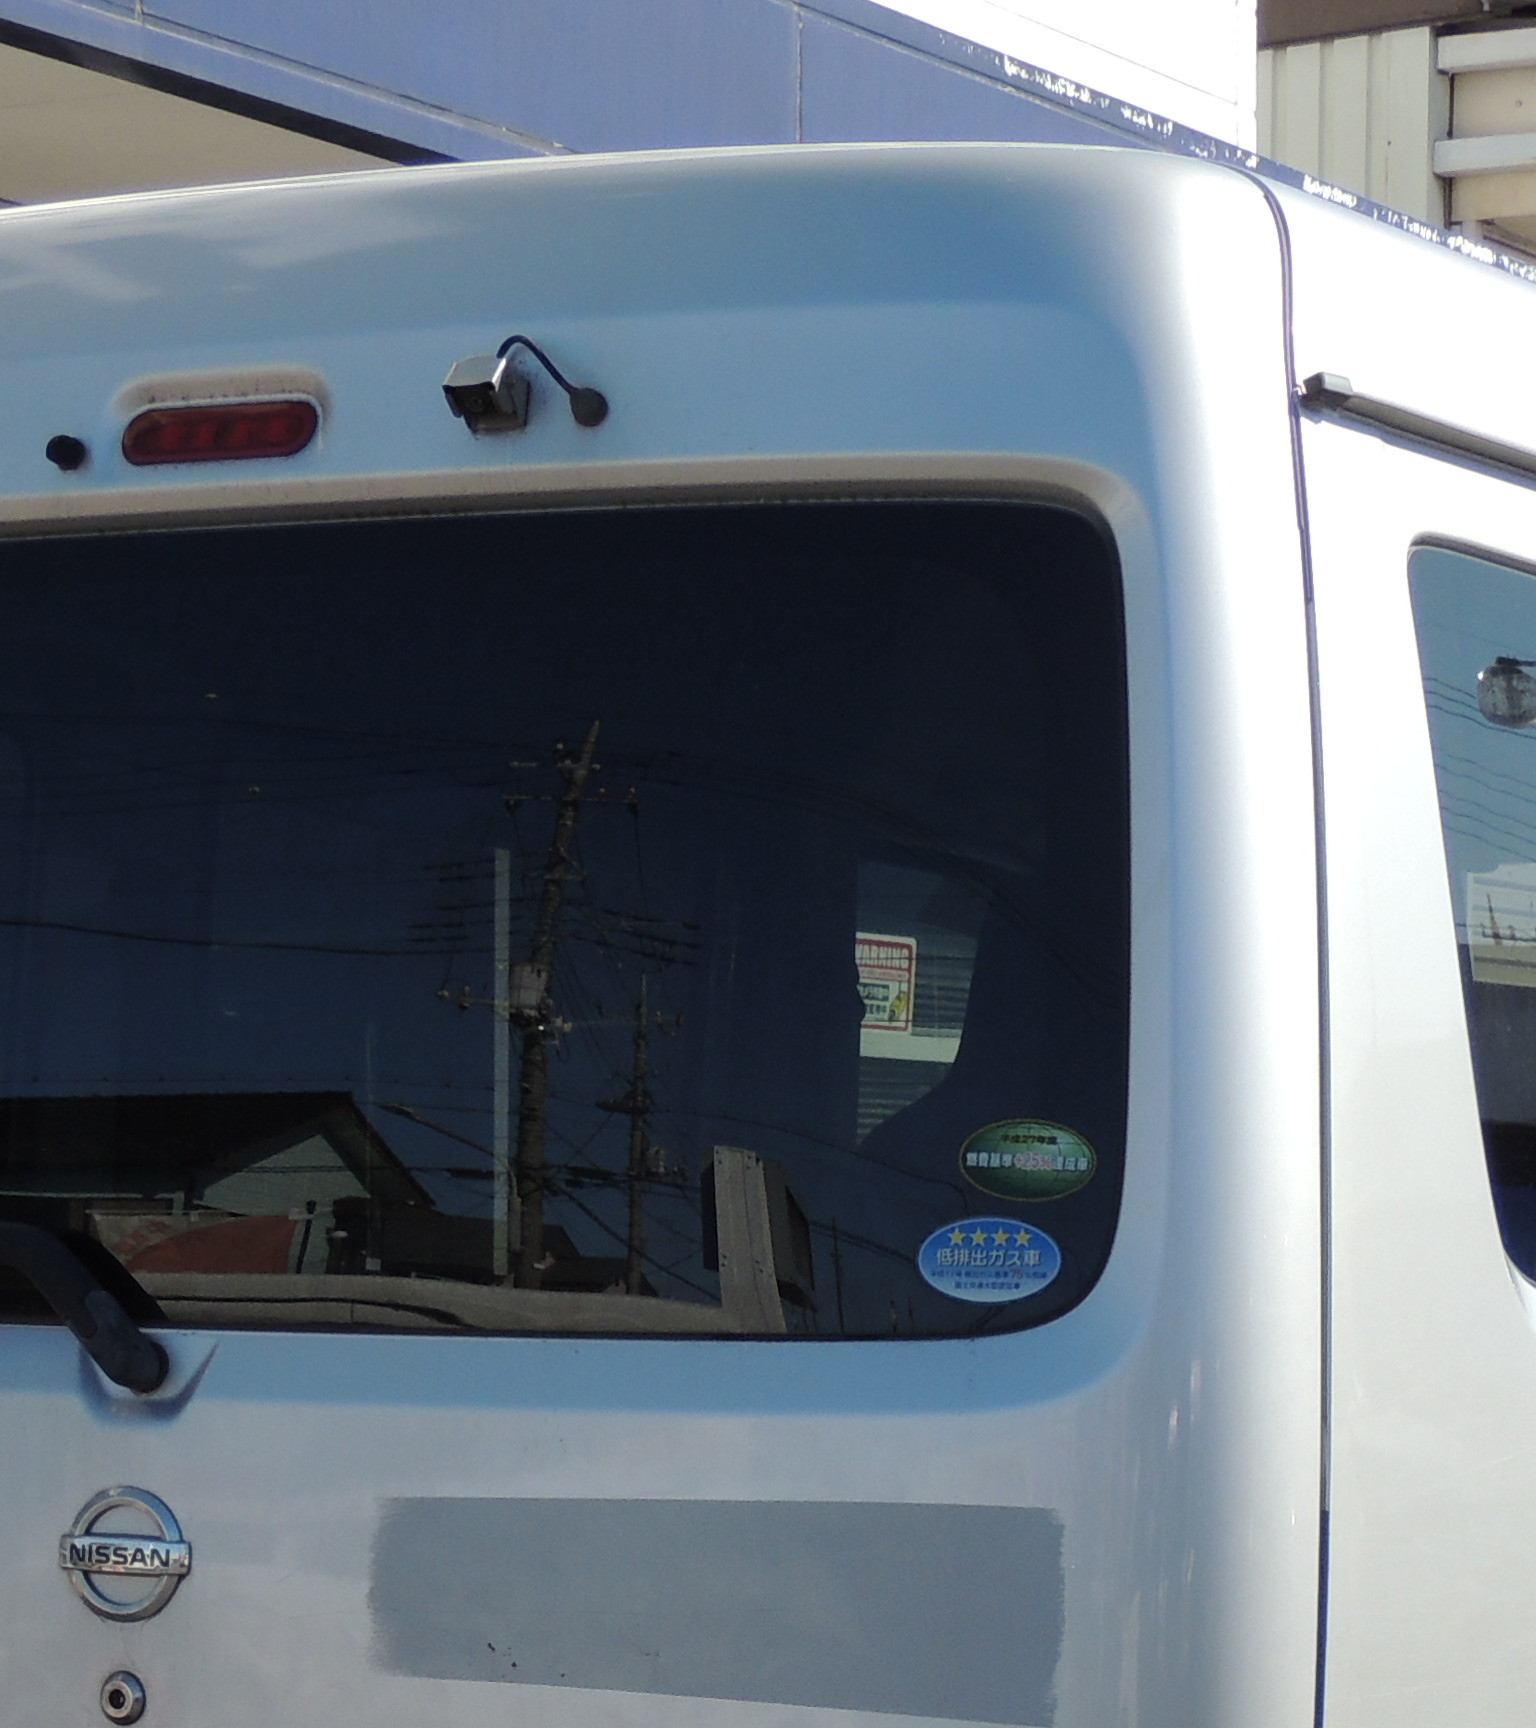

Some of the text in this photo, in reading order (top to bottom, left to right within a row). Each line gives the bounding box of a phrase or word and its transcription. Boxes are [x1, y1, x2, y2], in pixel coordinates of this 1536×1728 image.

[937, 1248, 1041, 1267] 低排出ガス車
[69, 1543, 171, 1568] NISSAN
